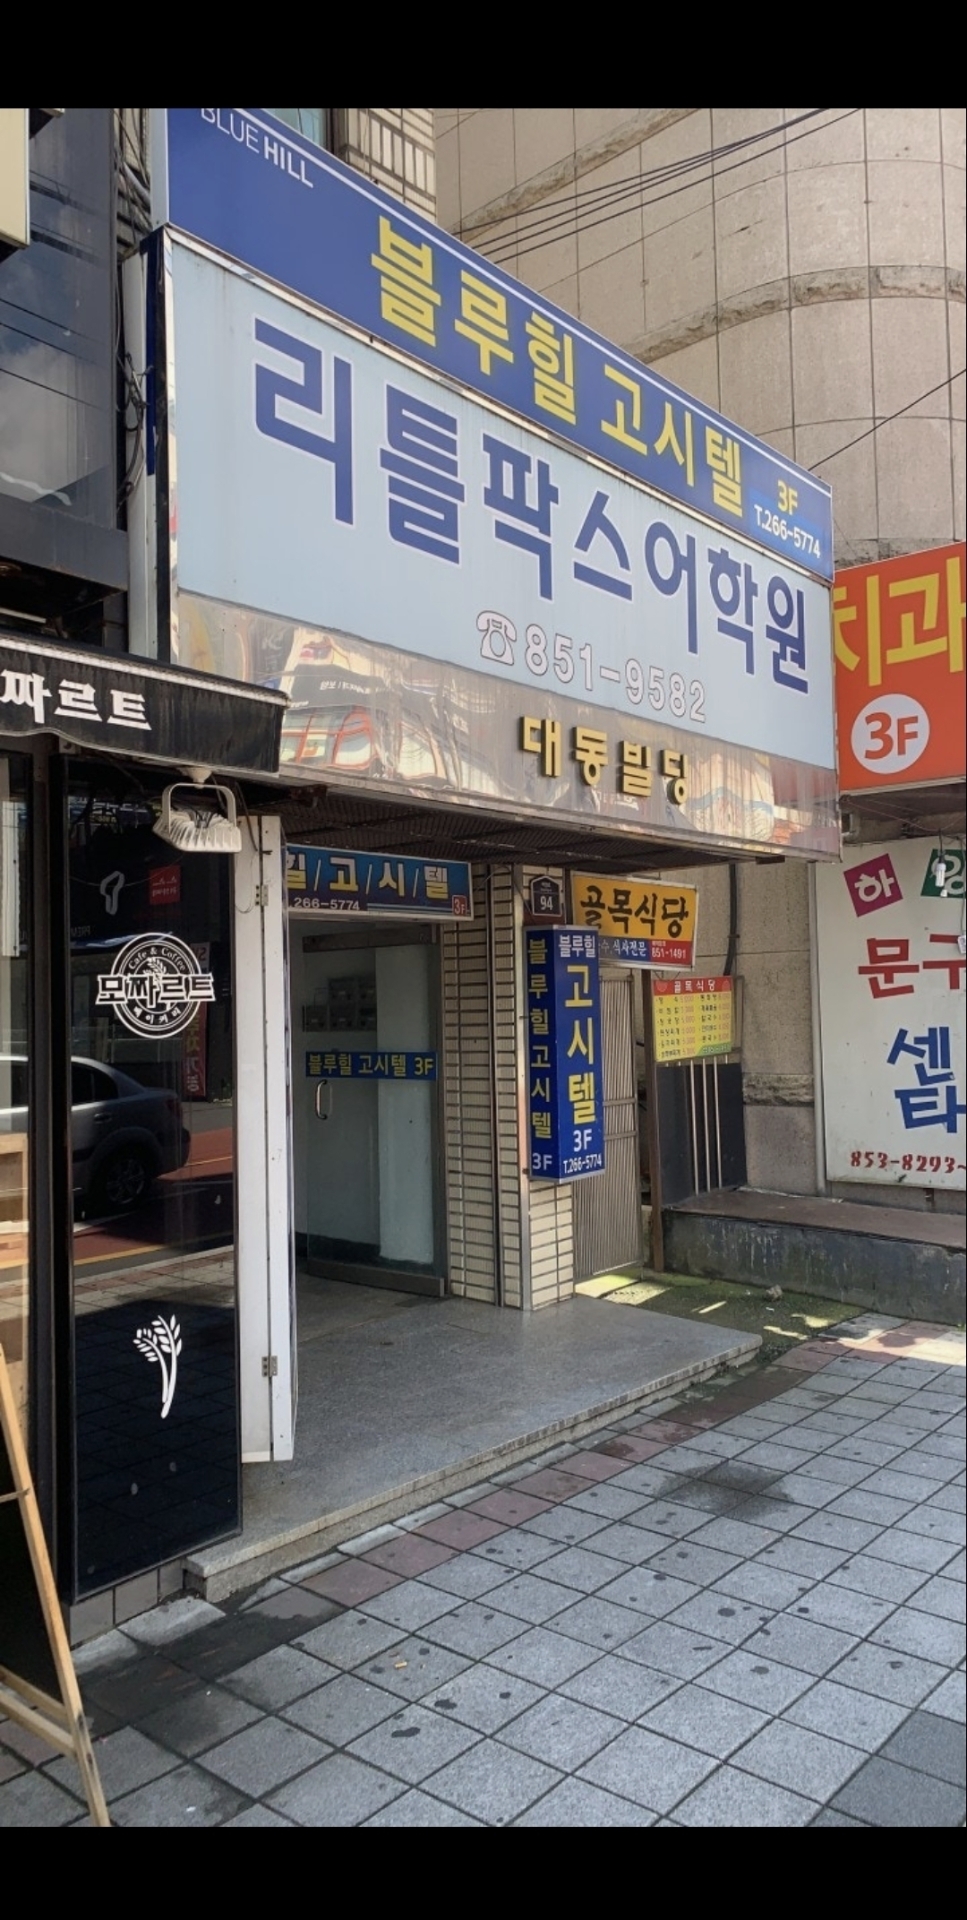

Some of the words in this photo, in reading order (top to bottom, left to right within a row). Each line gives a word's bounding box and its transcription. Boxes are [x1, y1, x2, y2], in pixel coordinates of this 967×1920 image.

[201, 108, 259, 154] BLUE
[264, 136, 314, 189] HILL
[371, 215, 577, 427] 블루힐
[601, 363, 744, 519] 고시텔
[253, 317, 810, 696] 리틀팍스어학원
[777, 479, 798, 516] 3F
[754, 503, 821, 559] T.266-5774
[525, 623, 706, 724] 851-9582
[864, 711, 919, 761] 3F
[519, 715, 689, 806] 대동빌딩
[454, 899, 467, 915] 3F
[540, 895, 553, 911] 94
[580, 885, 689, 938] 골목식당
[128, 951, 148, 970] Cafe
[161, 947, 187, 971] Coffee
[558, 934, 596, 958] 블루힐
[95, 972, 216, 1009] 모짜르트
[565, 964, 597, 1125] 고시텔
[308, 1053, 352, 1076] 블루힐
[358, 1054, 407, 1077] 고시텔
[414, 1057, 434, 1076] 3F
[573, 1129, 593, 1153] 3F
[532, 1152, 552, 1171] 3F
[563, 1153, 603, 1175] T.266-5774
